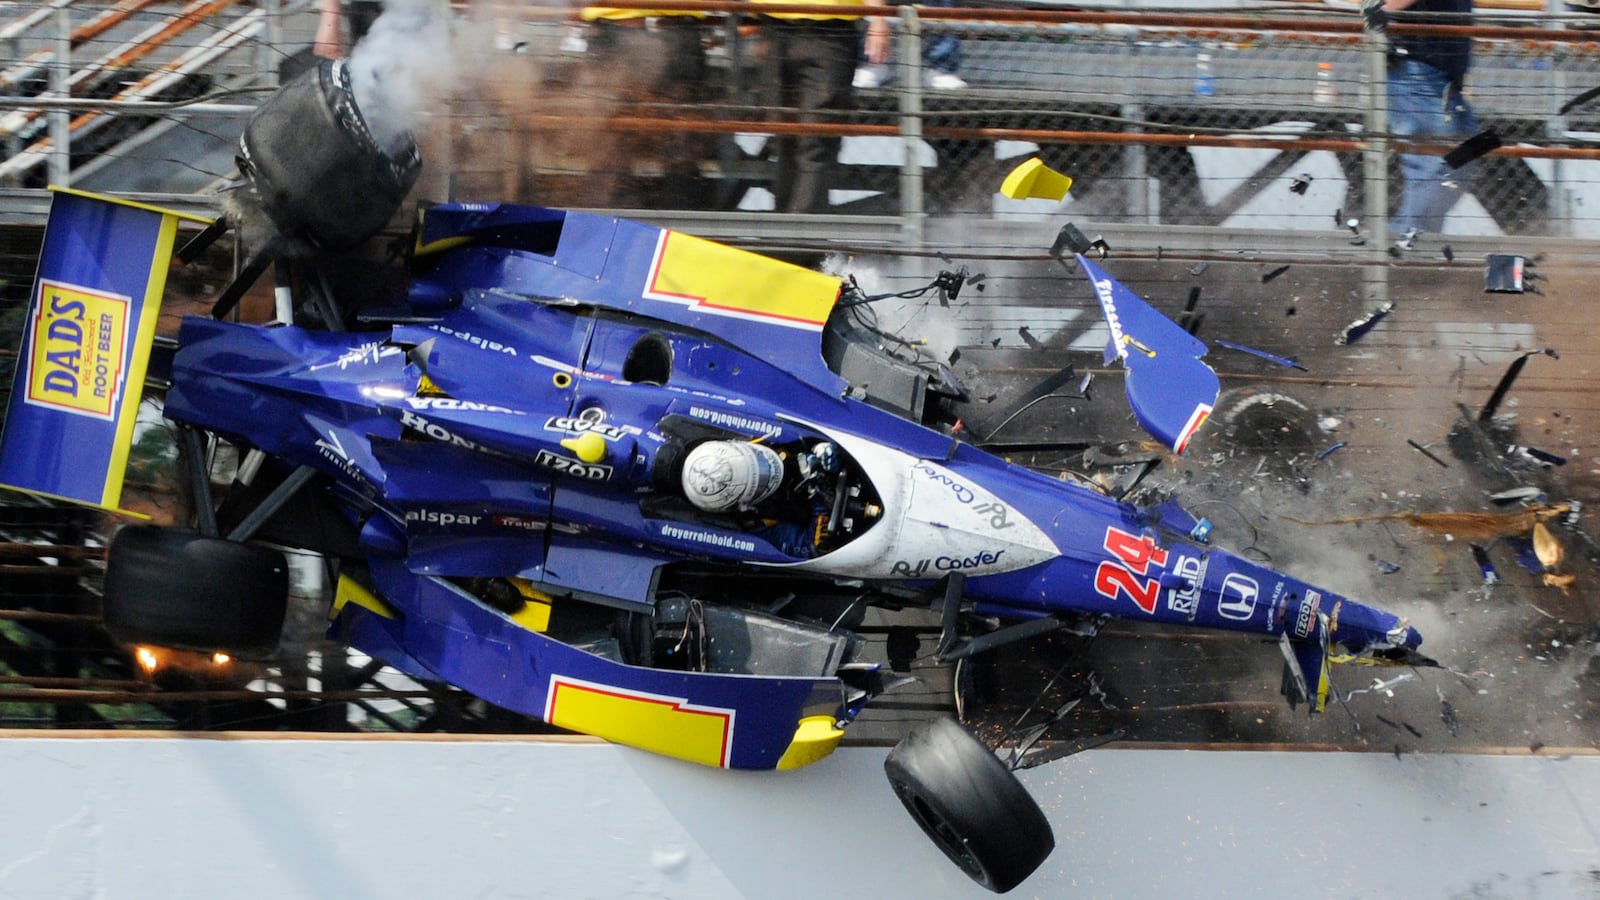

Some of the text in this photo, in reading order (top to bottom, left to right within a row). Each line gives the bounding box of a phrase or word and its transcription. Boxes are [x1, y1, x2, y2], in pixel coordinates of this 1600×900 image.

[43, 295, 86, 398] DAD'S
[93, 313, 114, 399] ROOT BEER
[428, 324, 518, 357] valspar
[539, 452, 606, 480] IZOD
[405, 508, 483, 527] alspar
[661, 524, 755, 552] dreyerreinbold.com
[1094, 525, 1170, 616] 24
[1297, 604, 1311, 634] IZOD
